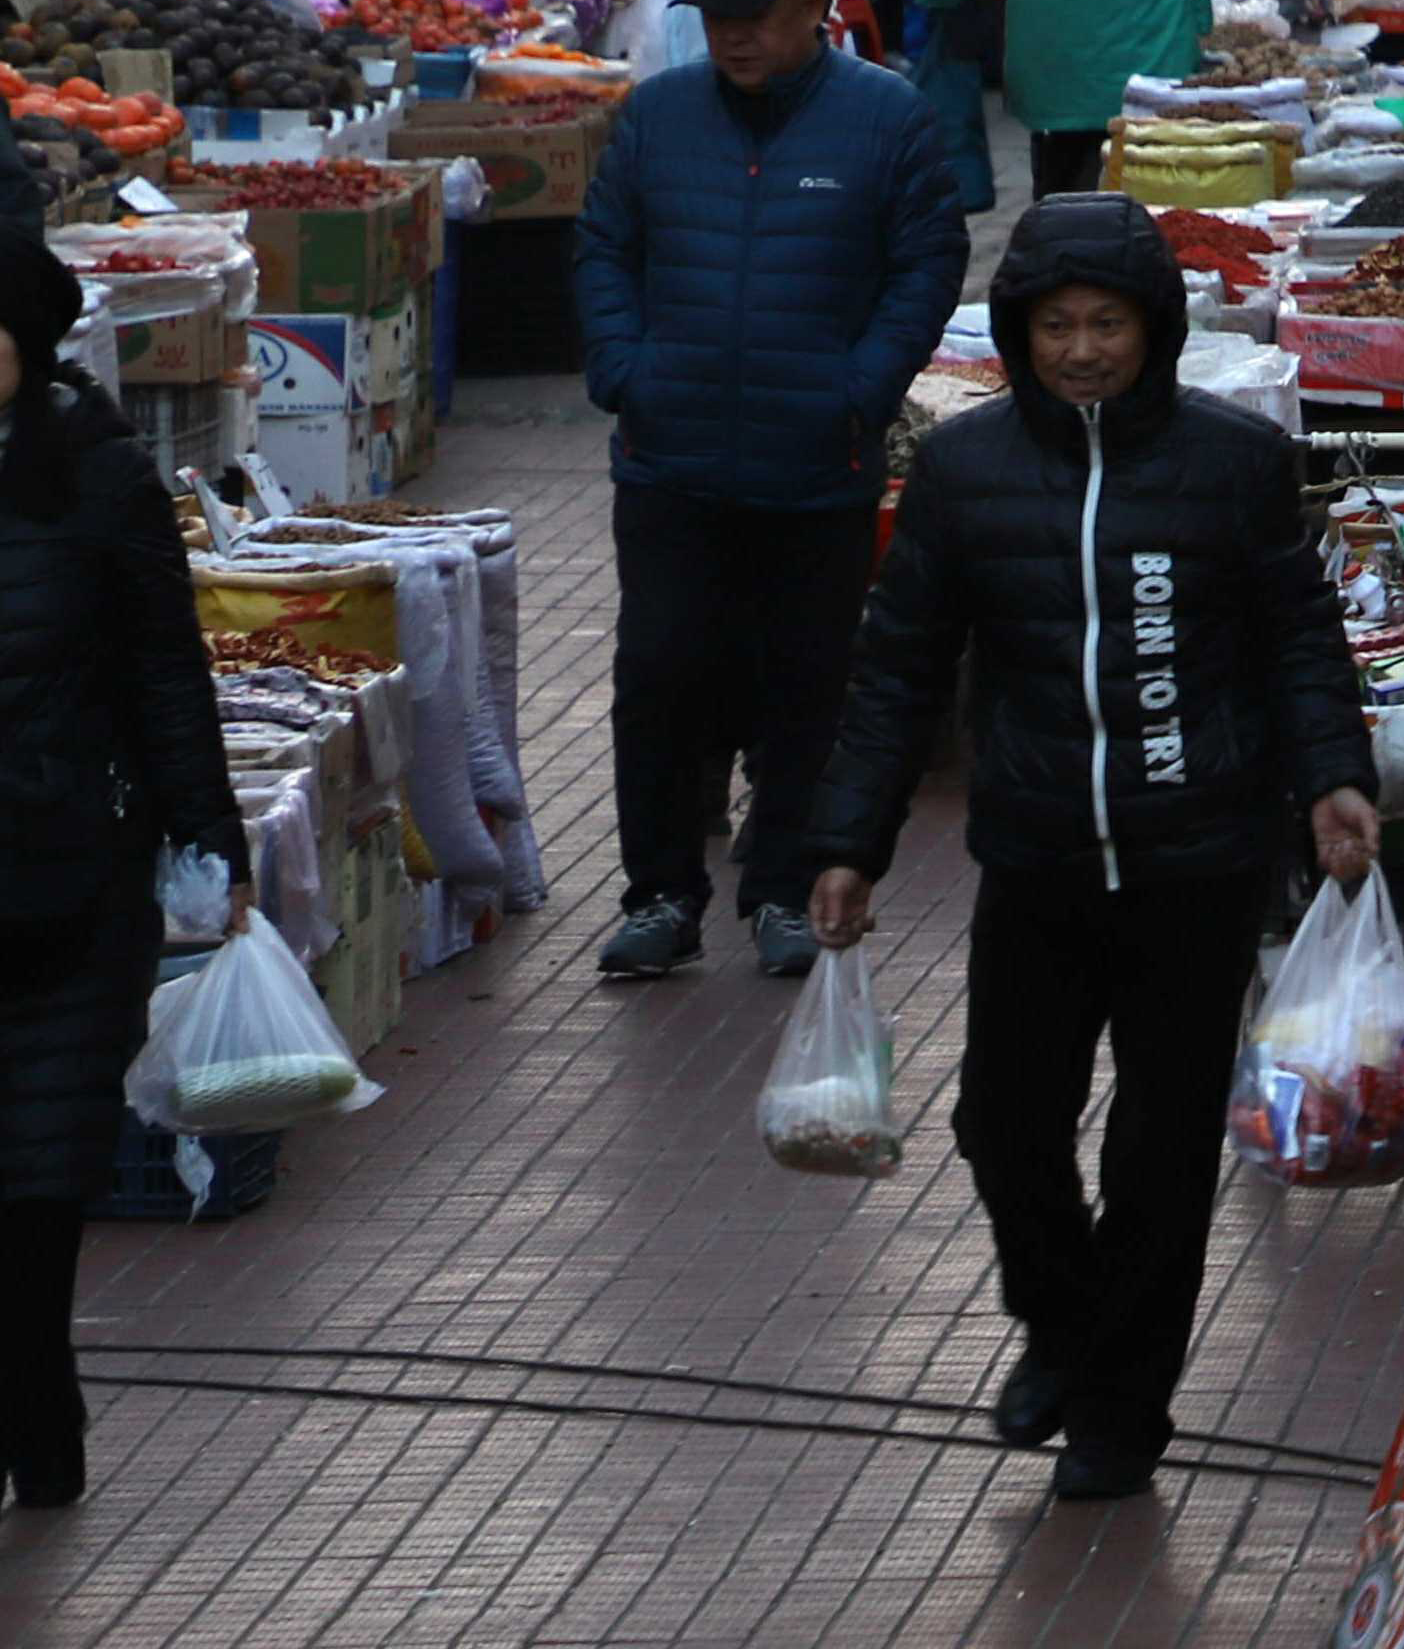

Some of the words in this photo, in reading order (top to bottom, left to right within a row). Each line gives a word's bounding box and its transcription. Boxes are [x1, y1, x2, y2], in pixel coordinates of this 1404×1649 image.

[1132, 552, 1175, 656] BORN
[1135, 664, 1178, 710] TO
[1142, 716, 1187, 784] TRY
